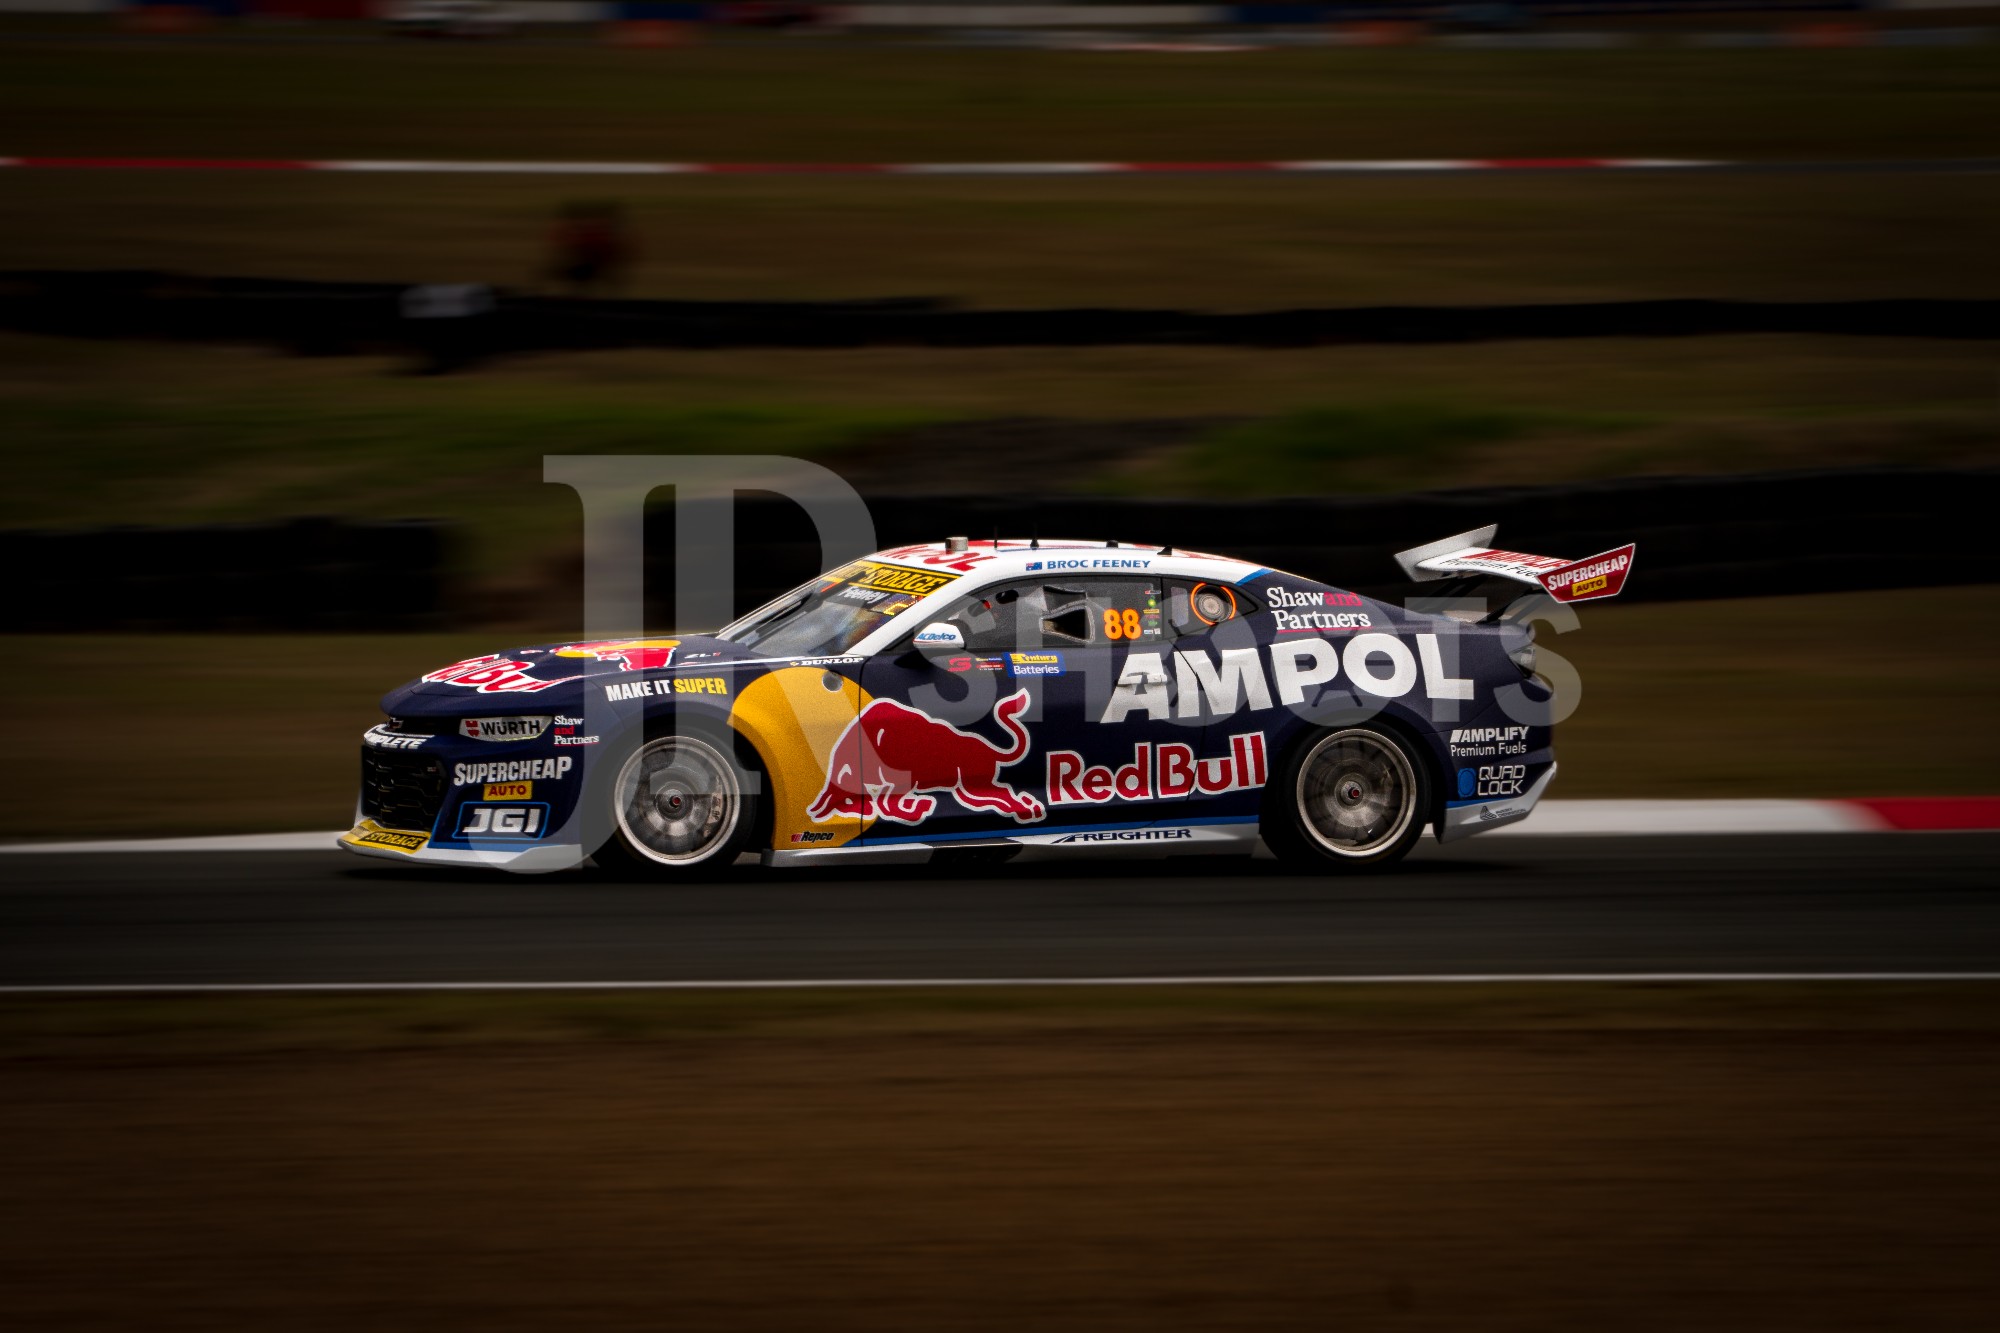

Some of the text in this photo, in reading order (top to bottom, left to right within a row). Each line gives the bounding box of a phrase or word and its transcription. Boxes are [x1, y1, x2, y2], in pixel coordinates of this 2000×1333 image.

[1047, 560, 1151, 569] BROC FEENEY
[1547, 554, 1628, 590] SUPERCHEAP
[859, 568, 948, 593] STORAGE
[1576, 579, 1604, 593] AUTO
[1266, 587, 1324, 607] Shaw
[1103, 608, 1142, 640] 88
[1271, 610, 1371, 630] Partners
[917, 633, 956, 641] ACDelco
[801, 657, 864, 665] DUNLOP
[1014, 665, 1060, 674] Batteries
[1100, 633, 1474, 724] AMPOL
[605, 678, 728, 702] MAKE IT SUPER
[554, 715, 584, 725] Shaw
[554, 726, 574, 735] and
[1460, 726, 1530, 743] AMPLIFY
[554, 735, 600, 744] Partners
[1451, 741, 1527, 757] Premium Fuels
[453, 756, 572, 786] SUPERCHEAP
[1047, 731, 1268, 804] Red Bull
[1478, 765, 1526, 781] QUAD
[487, 785, 527, 797] AUTO
[1477, 780, 1523, 796] LOCK
[462, 808, 541, 833] JGI
[366, 832, 424, 847] STORAGE
[801, 831, 834, 843] Repco
[1058, 828, 1192, 843] FREIGHTER
